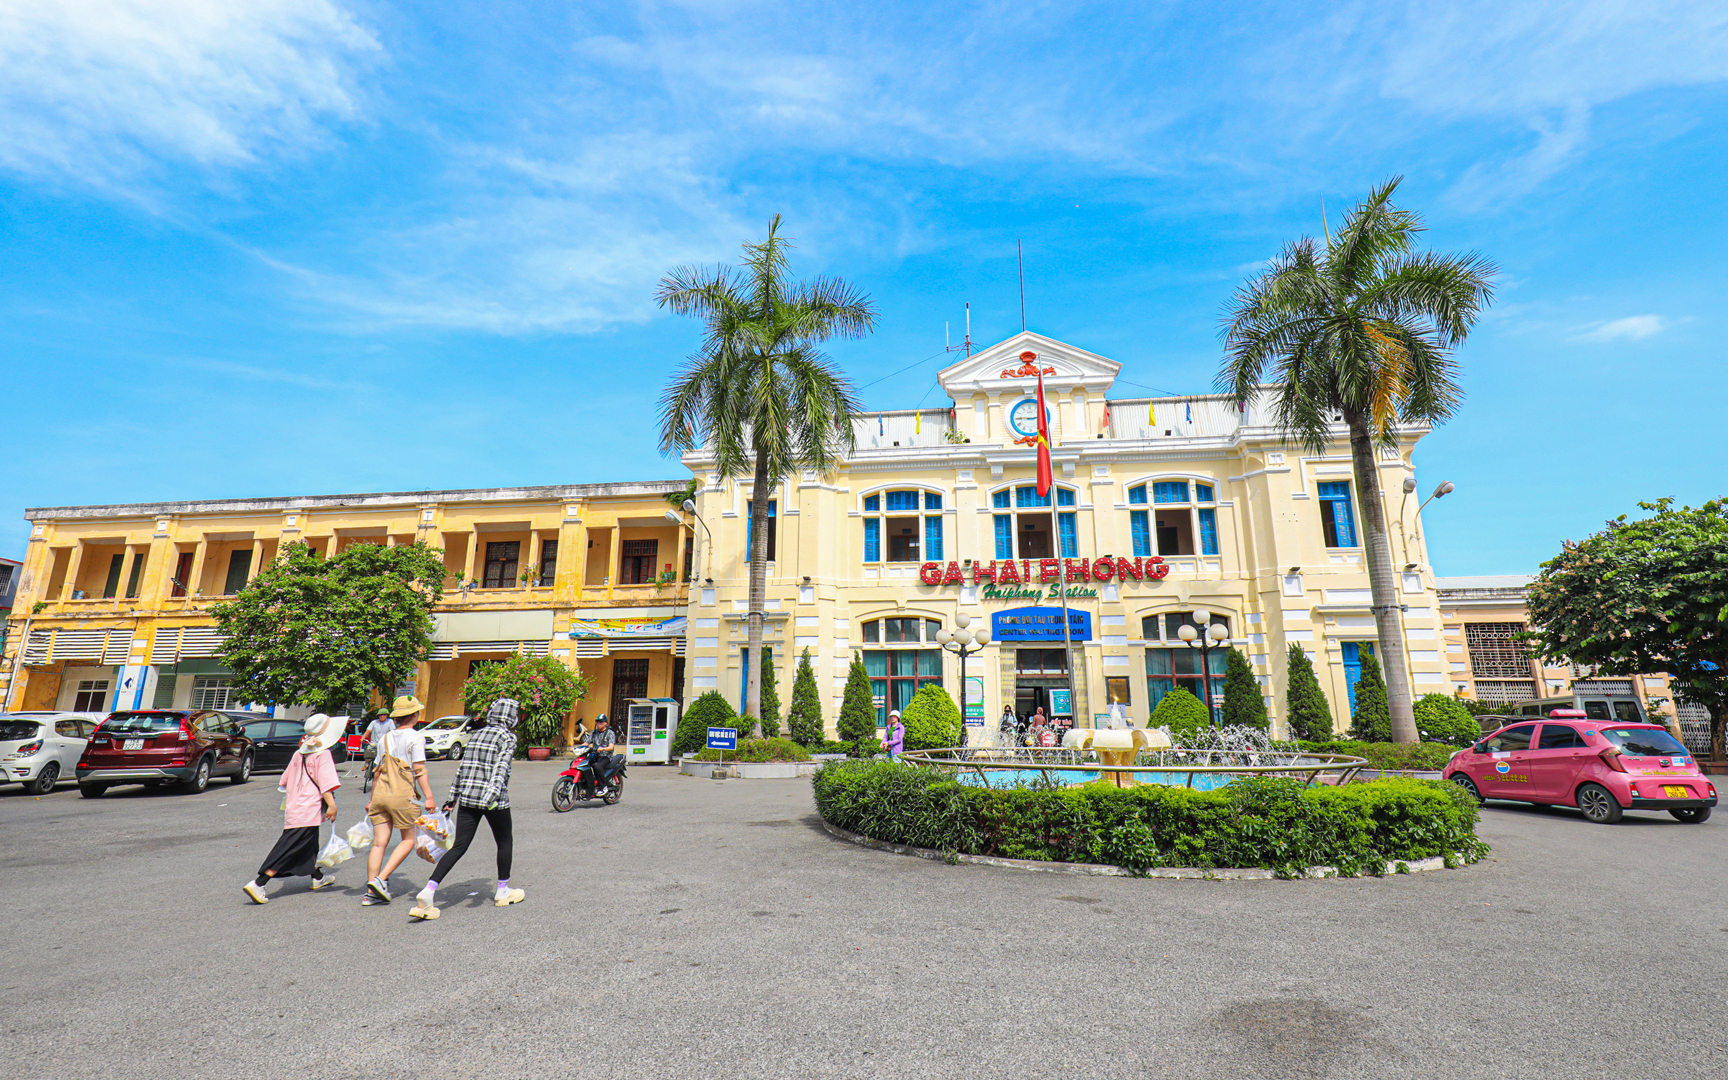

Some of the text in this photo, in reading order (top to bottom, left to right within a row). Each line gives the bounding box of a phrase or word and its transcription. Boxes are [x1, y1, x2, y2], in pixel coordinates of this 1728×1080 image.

[920, 561, 965, 585] GA
[973, 559, 1031, 583] HAI
[983, 582, 1098, 602] Haiphong Sation
[998, 614, 1020, 625] PHÒNG
[1033, 614, 1046, 625] TÀU
[1046, 615, 1064, 625] TRUN
[1069, 613, 1084, 624] TÂM
[998, 628, 1027, 636] CENTER
[1028, 628, 1060, 636] WAITING
